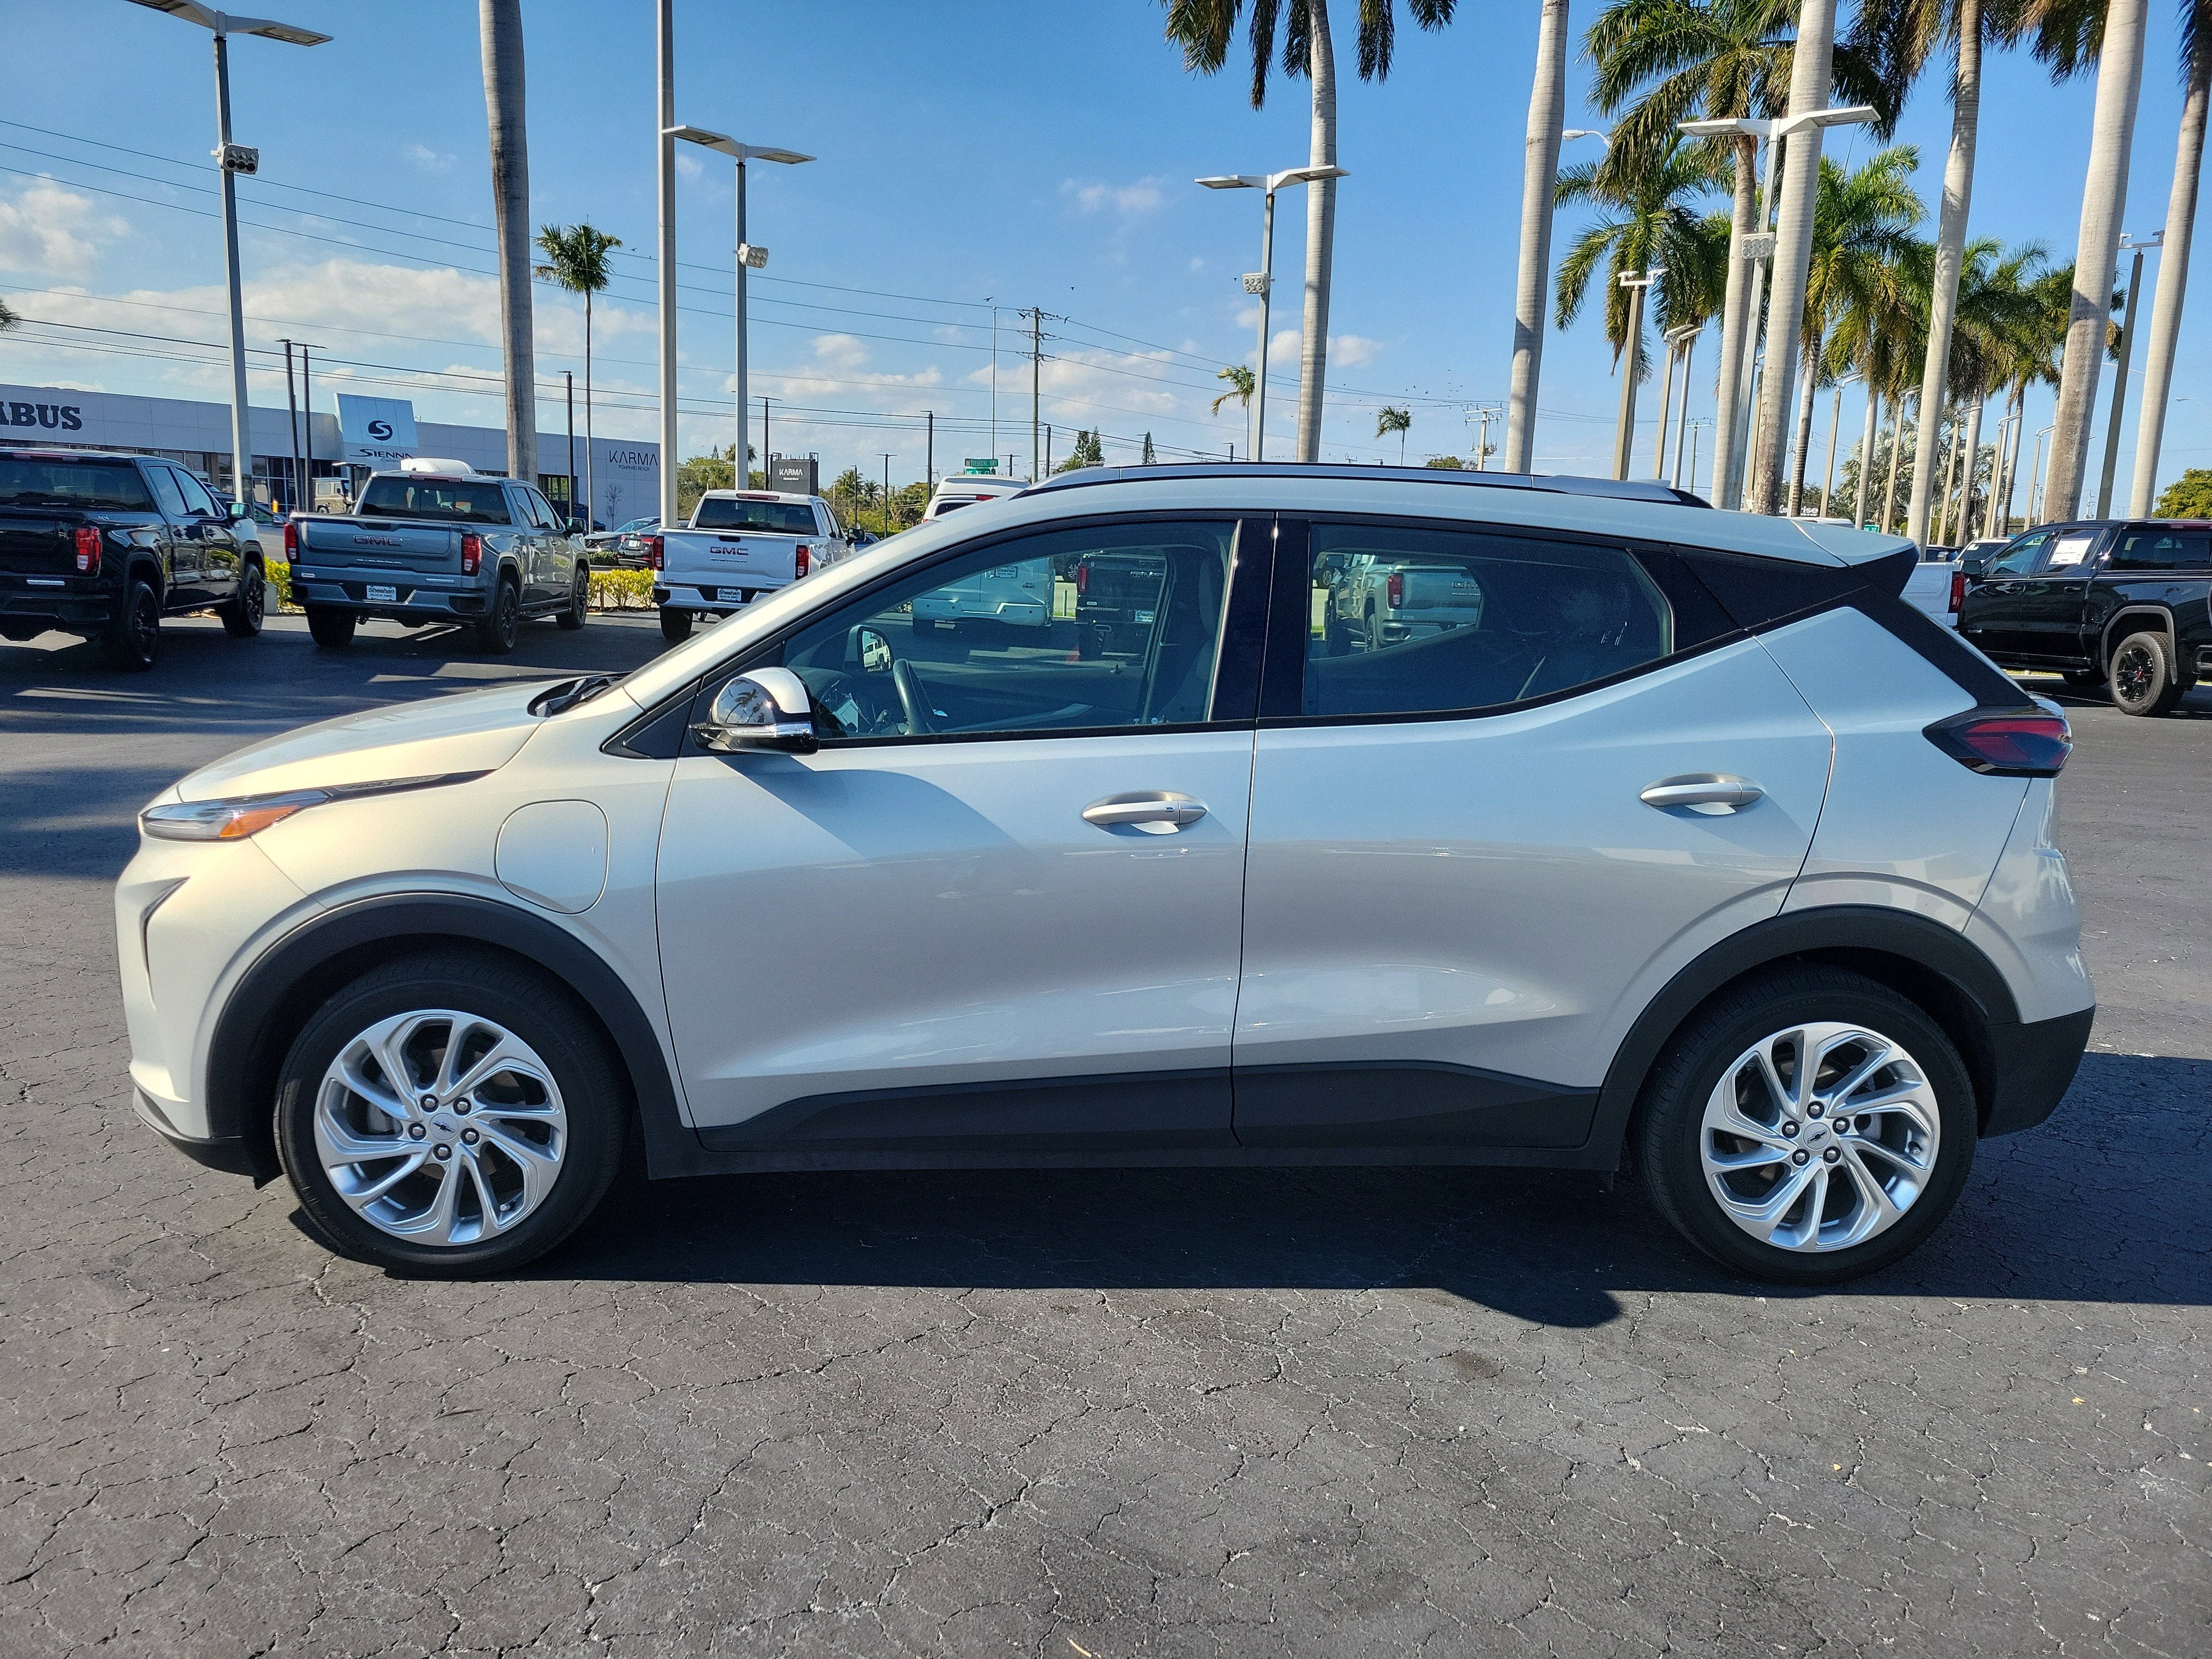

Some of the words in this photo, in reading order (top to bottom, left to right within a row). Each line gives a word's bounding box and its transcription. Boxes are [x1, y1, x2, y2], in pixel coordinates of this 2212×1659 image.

[609, 450, 658, 466] KARMA
[779, 468, 803, 476] KARMA
[353, 535, 403, 546] GMC
[710, 546, 749, 556] GMC
